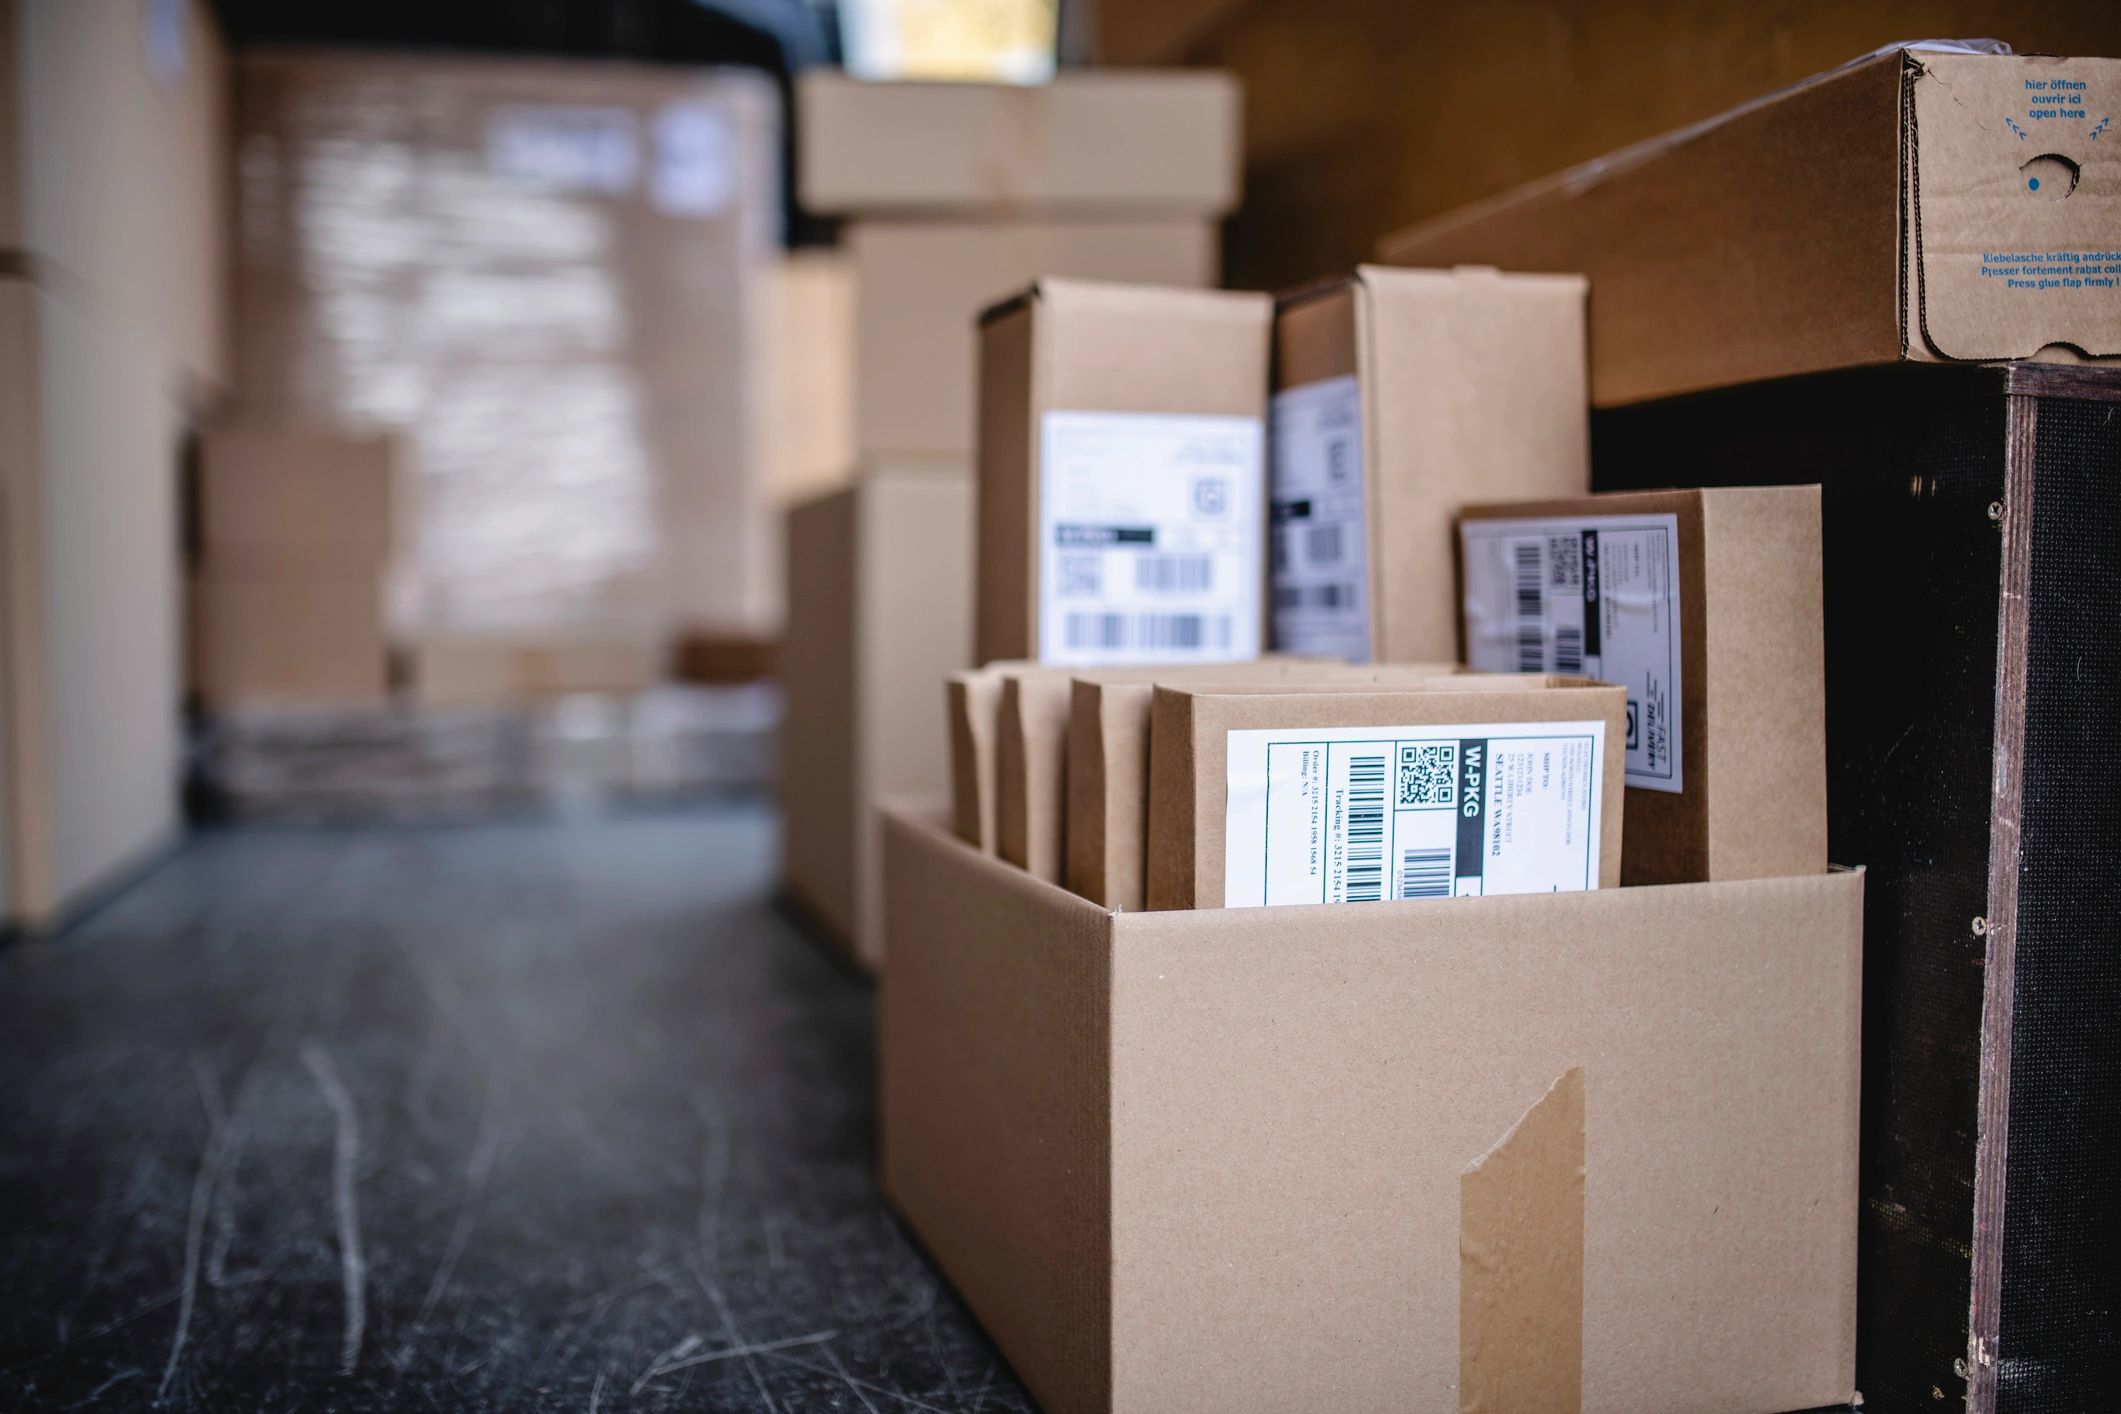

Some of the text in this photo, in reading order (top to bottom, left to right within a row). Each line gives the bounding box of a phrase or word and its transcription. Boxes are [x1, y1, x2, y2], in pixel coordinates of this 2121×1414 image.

[2025, 80, 2087, 90] hier öffnen
[2032, 94, 2081, 104] ouvrir ici
[2029, 108, 2086, 120] open here
[1983, 253, 2043, 263] Klebelasche
[2046, 252, 2080, 263] kräftig
[1981, 267, 2019, 276] Presser
[2022, 266, 2073, 276] fortement
[2076, 265, 2102, 275] rabat
[2008, 279, 2036, 288] Press
[2039, 278, 2061, 289] glue
[2063, 278, 2082, 289] flap
[2084, 277, 2114, 289] firmly
[1647, 704, 1656, 771] DELIVERY
[1656, 726, 1667, 764] FAST
[1301, 751, 1310, 780] Billing:
[1312, 750, 1320, 774] Order
[1312, 776, 1319, 784] #:
[1463, 746, 1482, 818] W-PKG
[1542, 775, 1550, 789] TO:
[1311, 786, 1319, 805] 3215
[1334, 789, 1344, 831] Tracking
[1492, 754, 1504, 857] SEATTLE WA98102
[1334, 833, 1343, 842] #:
[1505, 812, 1513, 844] STREET
[1334, 845, 1343, 867] 3215
[1310, 866, 1317, 876] 54
[1334, 869, 1342, 891] 2154
